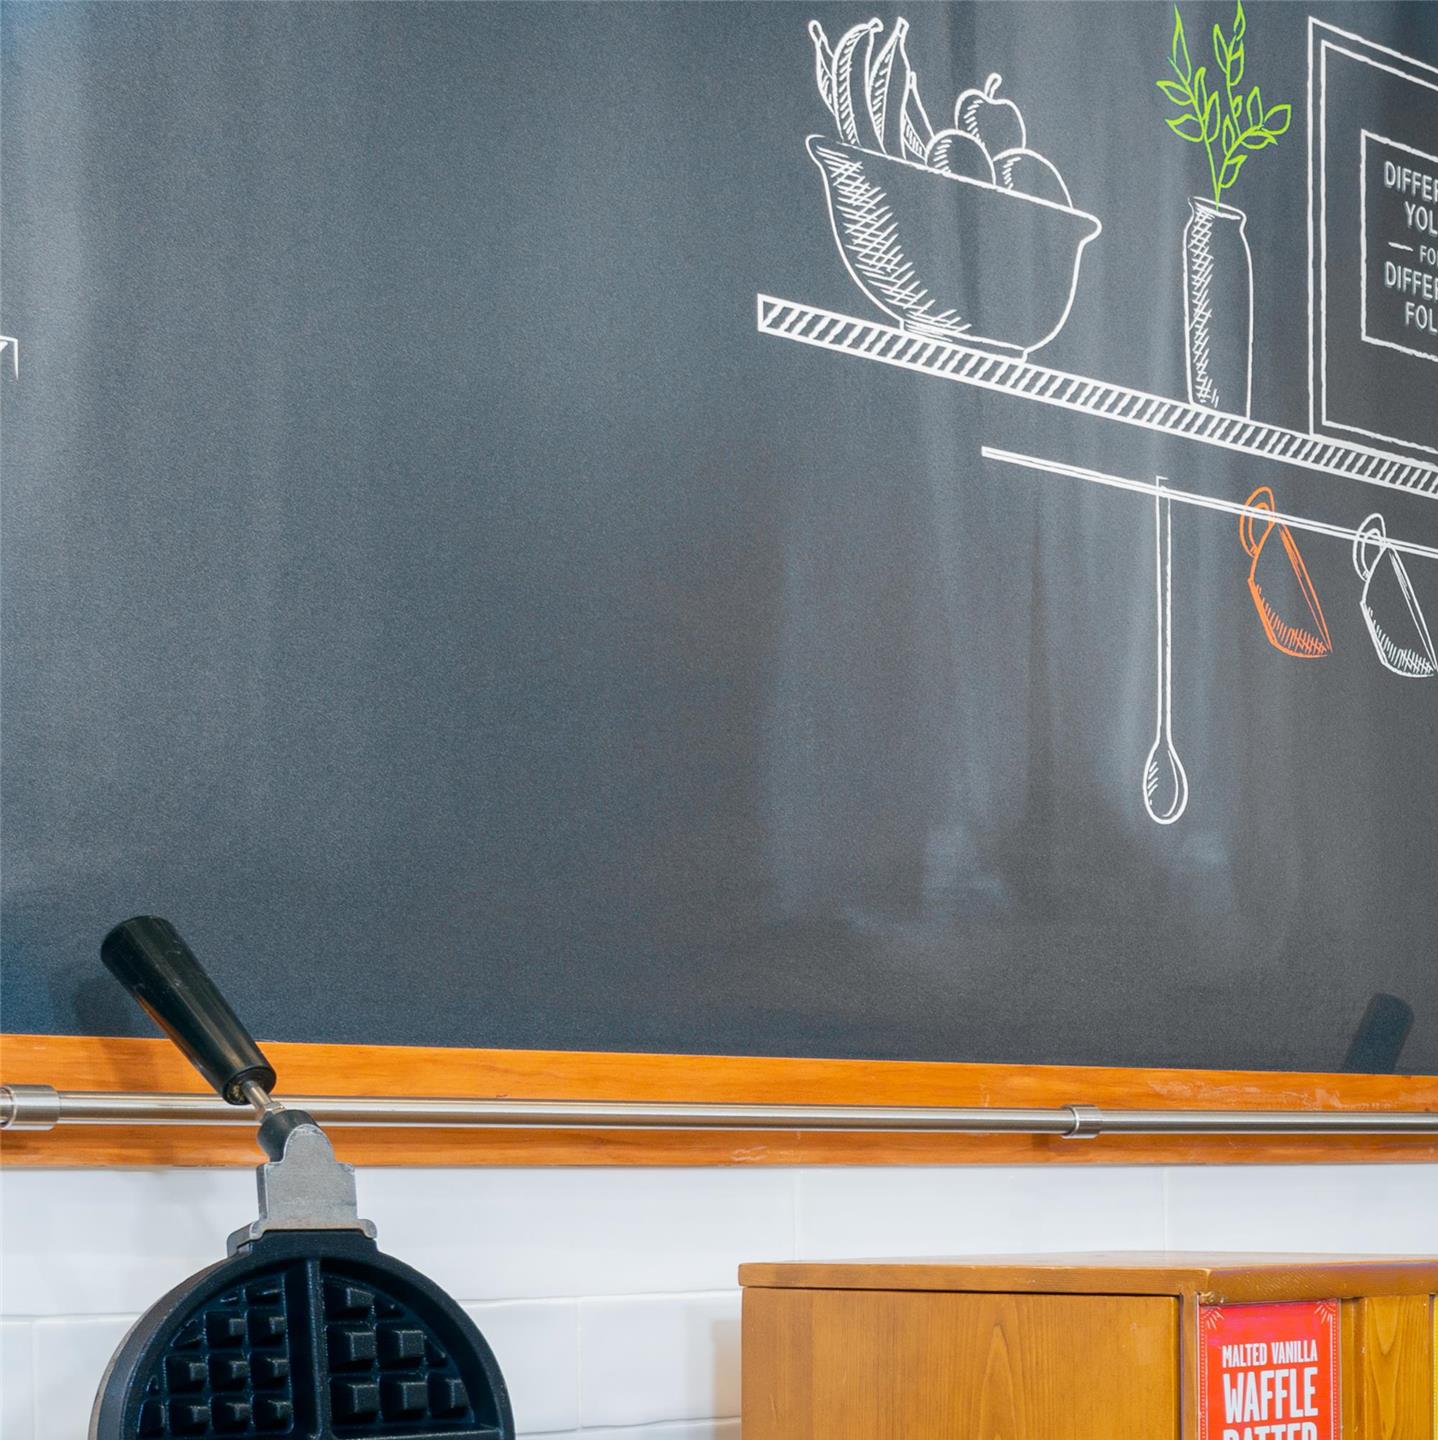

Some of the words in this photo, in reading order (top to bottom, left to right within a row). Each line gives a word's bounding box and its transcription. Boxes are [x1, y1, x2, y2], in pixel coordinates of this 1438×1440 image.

[1222, 1342, 1268, 1368] MALTED
[1271, 1339, 1318, 1365] VANILLA
[1222, 1366, 1319, 1424] WAFFLE
